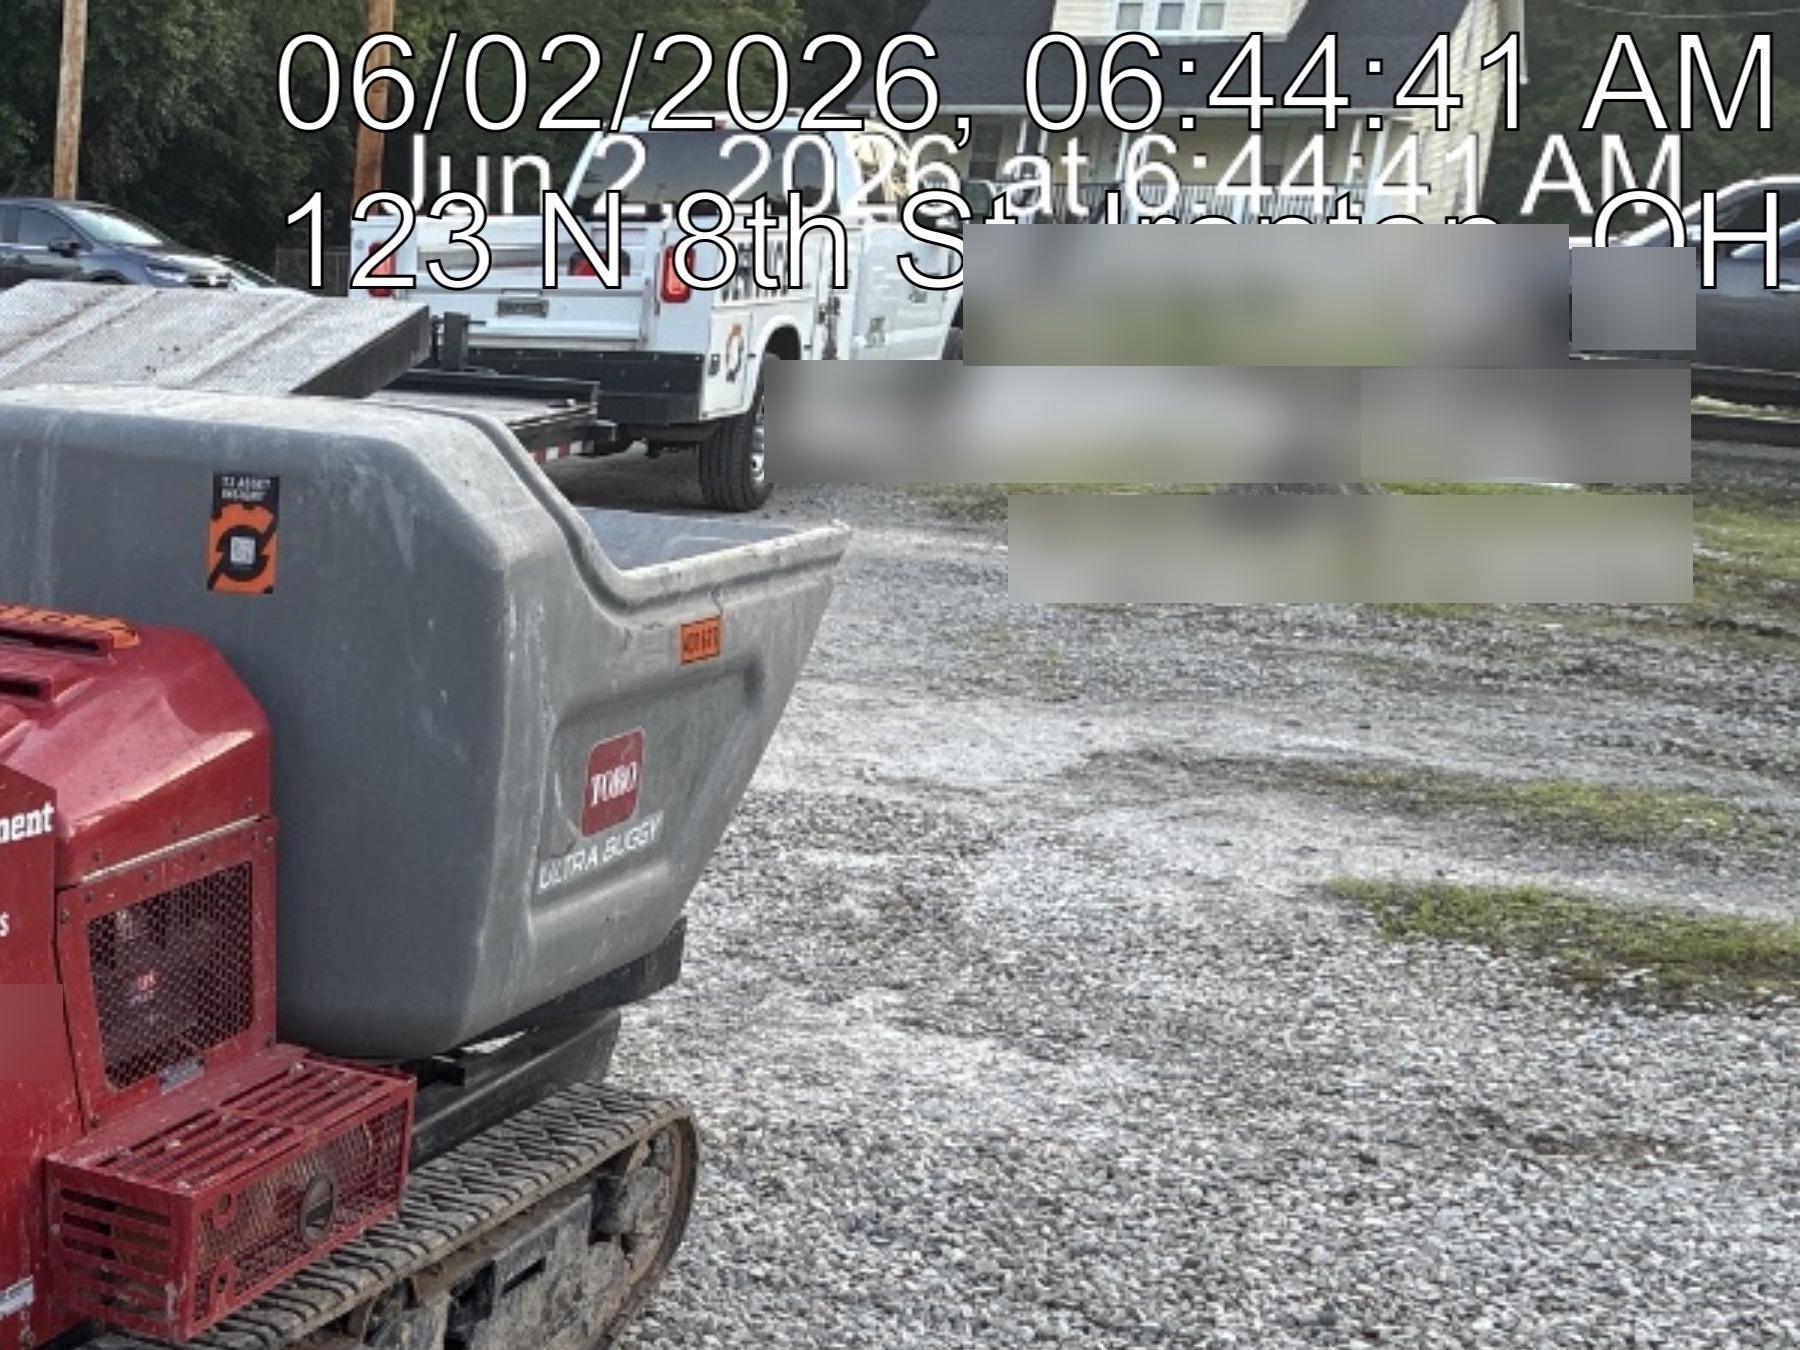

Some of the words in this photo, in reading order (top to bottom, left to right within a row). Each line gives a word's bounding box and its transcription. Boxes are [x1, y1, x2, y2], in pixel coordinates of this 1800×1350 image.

[591, 761, 638, 808] TORO
[538, 843, 599, 891] ULTRA
[602, 810, 665, 863] BUGGY
